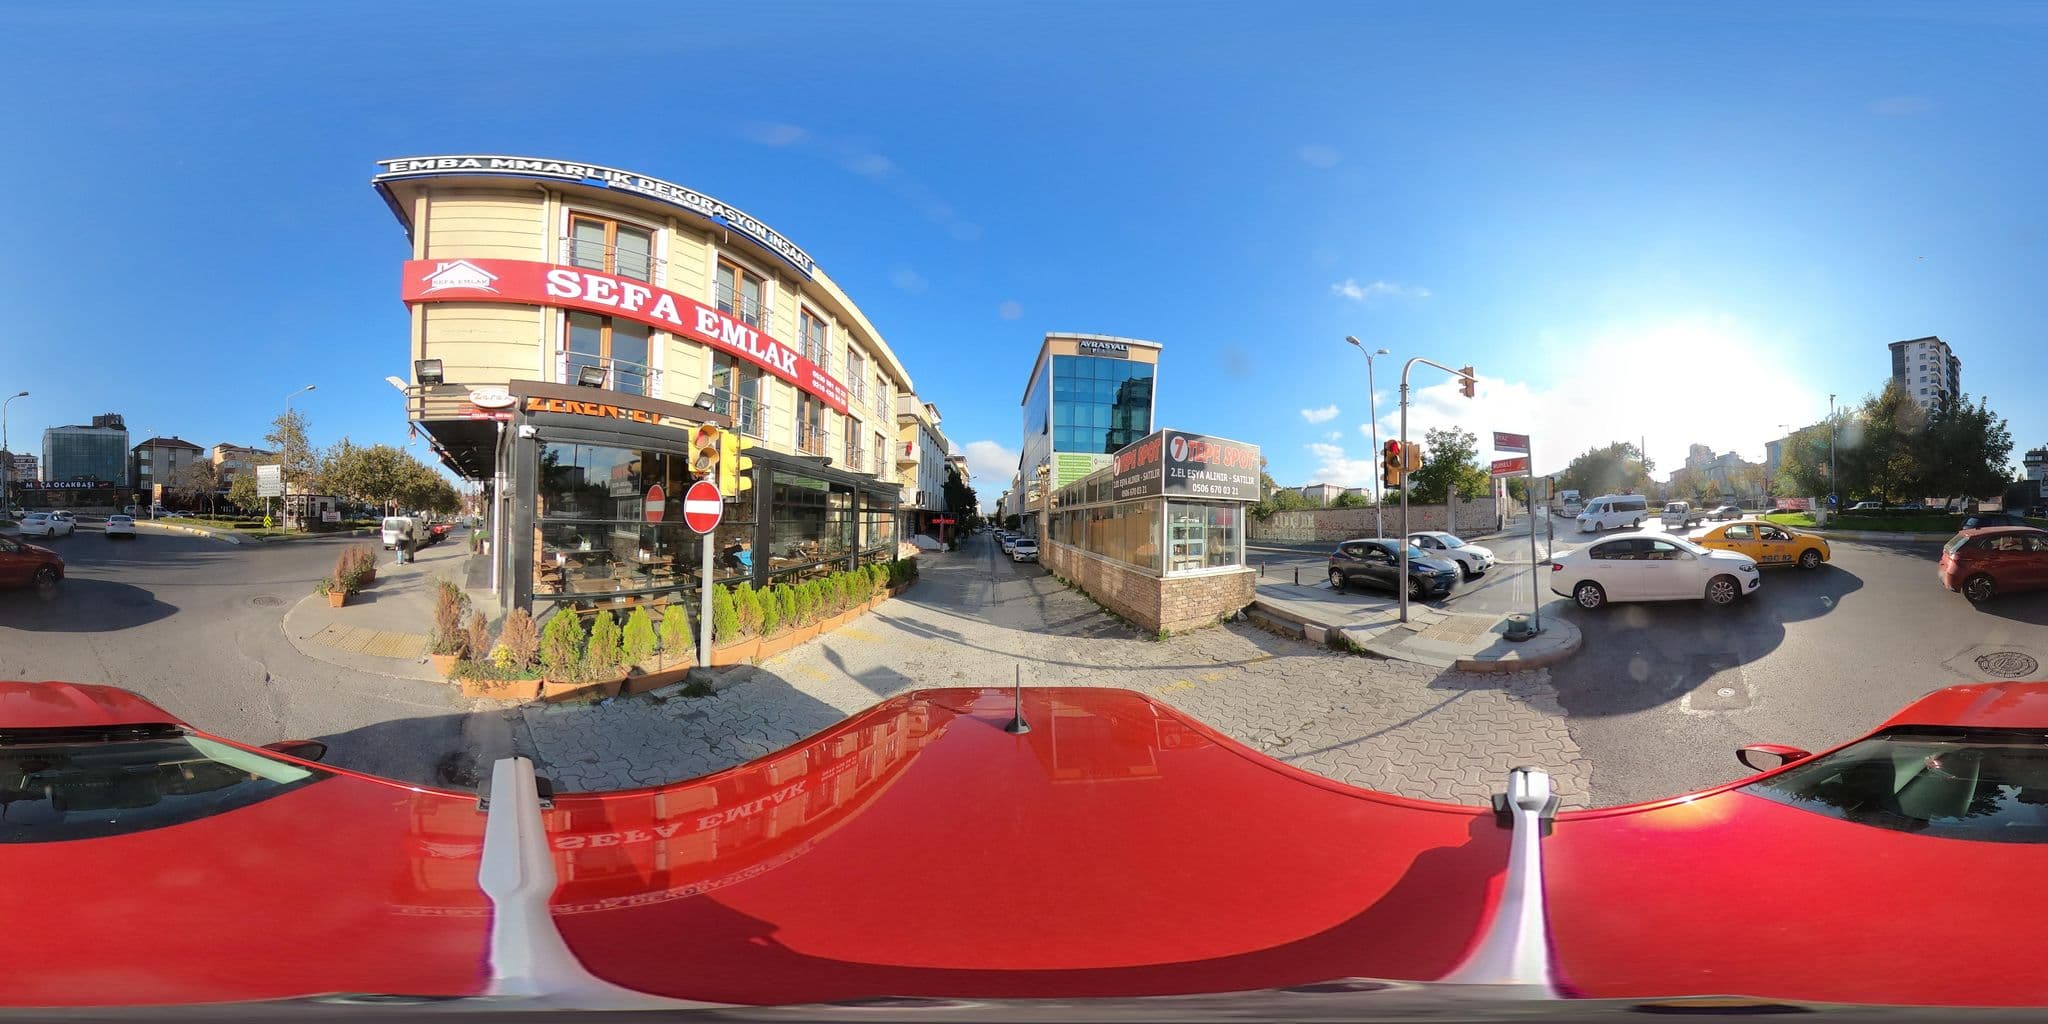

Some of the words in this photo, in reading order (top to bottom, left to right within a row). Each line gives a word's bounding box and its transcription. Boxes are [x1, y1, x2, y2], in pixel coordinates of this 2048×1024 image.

[389, 158, 482, 173] EMBA
[638, 172, 767, 238] DEKORASYON
[546, 269, 683, 325] SEFA
[695, 305, 799, 379] EMLAK
[1223, 446, 1257, 471] SPOT
[1170, 467, 1186, 478] 2.EL
[1187, 469, 1205, 480] EŞYA
[1205, 471, 1228, 482] ALINIR
[1232, 474, 1255, 485] SATILIR
[1192, 483, 1209, 493] 0506
[1210, 485, 1222, 493] 670
[1222, 486, 1231, 495] 03
[1231, 486, 1239, 495] 21
